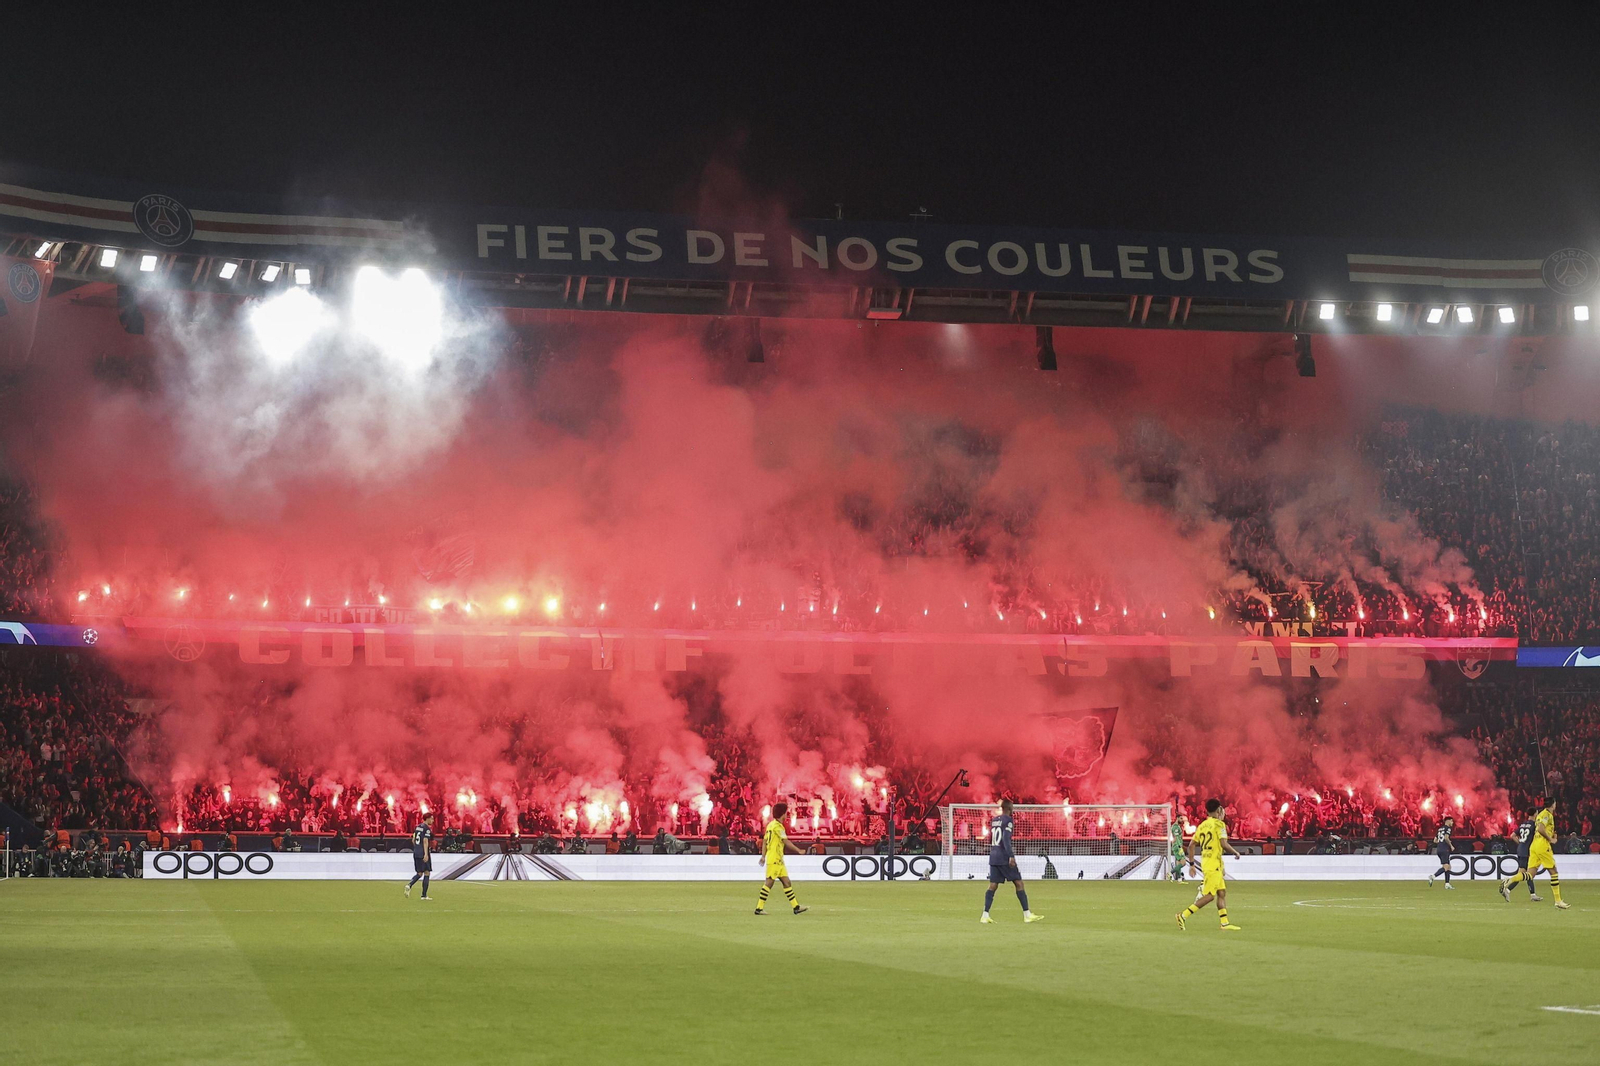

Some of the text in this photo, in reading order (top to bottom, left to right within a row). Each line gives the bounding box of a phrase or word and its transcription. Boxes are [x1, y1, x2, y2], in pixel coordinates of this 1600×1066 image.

[142, 197, 181, 211] PARIS
[476, 223, 1285, 284] FIERS DE NOS COULEURS
[1551, 250, 1589, 262] PARIS
[238, 625, 1426, 680] COLLECTIF ULTAS PARIS
[415, 832, 421, 845] 5
[991, 826, 1002, 847] 10
[1199, 831, 1213, 852] 22
[1518, 828, 1530, 843] 33
[153, 851, 274, 879] oppo
[822, 855, 937, 880] oppo
[1448, 855, 1547, 880] opp
